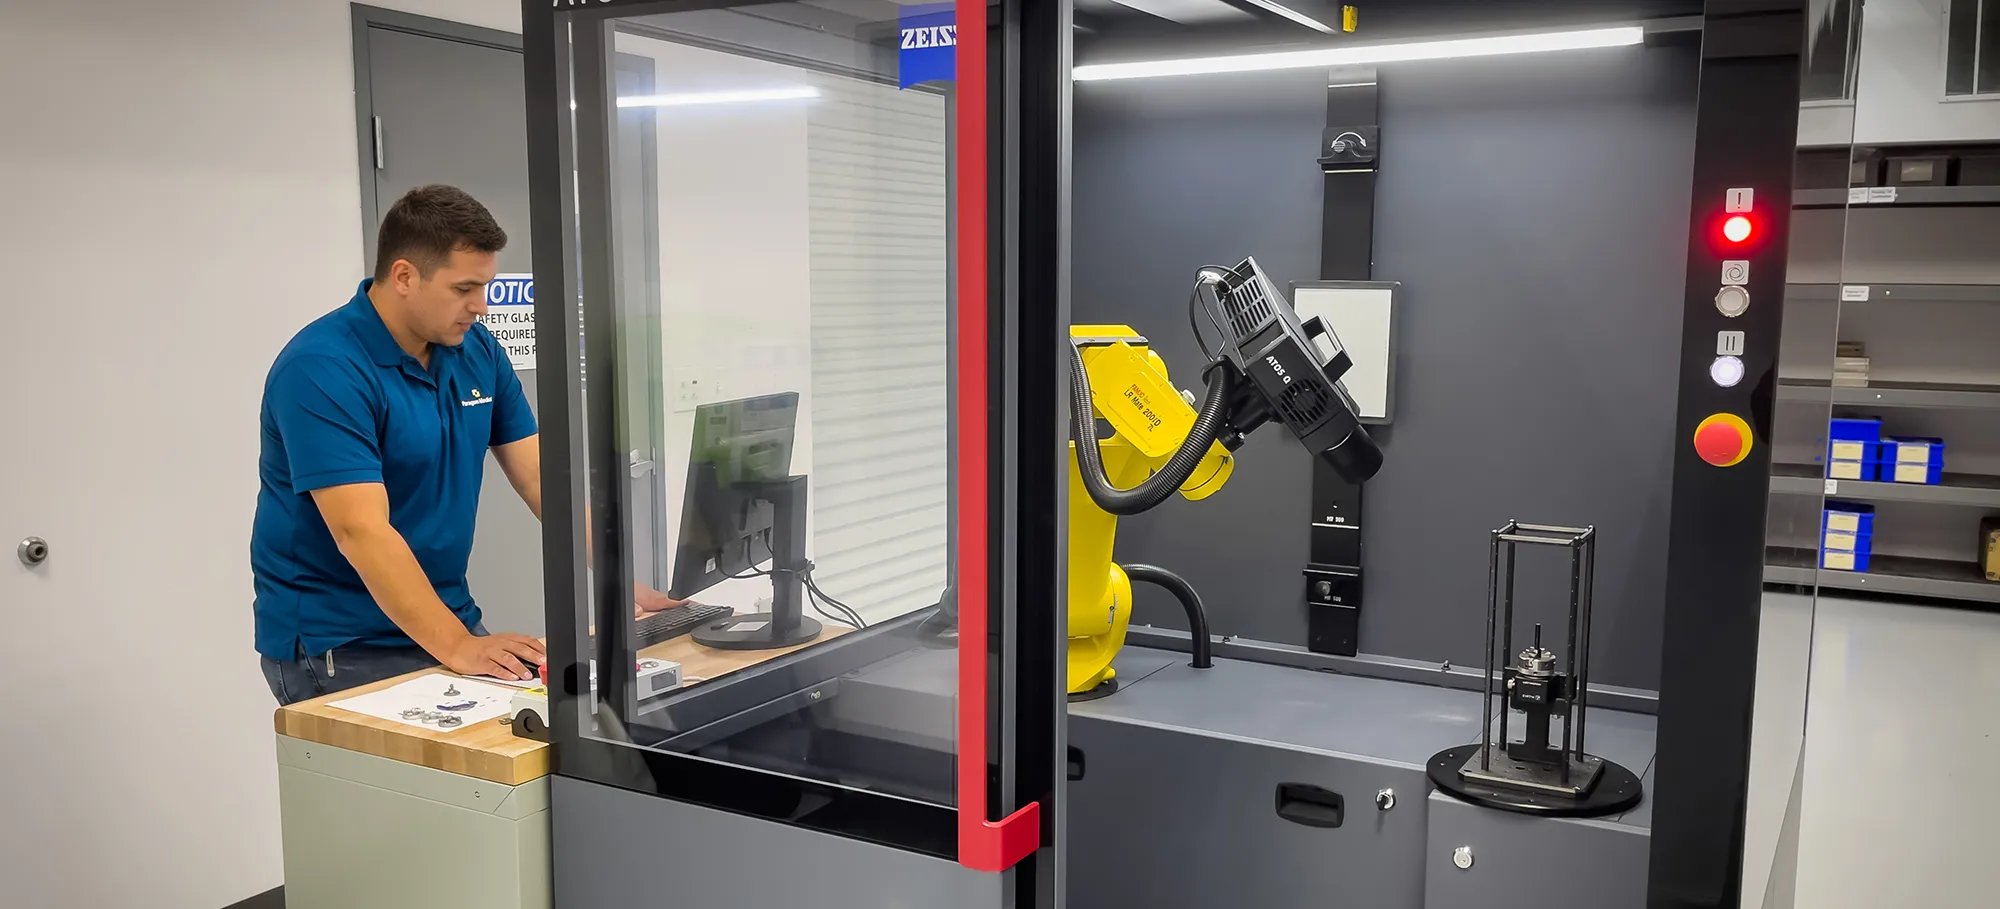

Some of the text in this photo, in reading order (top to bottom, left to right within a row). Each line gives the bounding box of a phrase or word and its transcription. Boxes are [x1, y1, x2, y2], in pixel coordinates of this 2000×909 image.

[901, 25, 957, 49] ZEIS
[508, 345, 530, 356] THIS
[1265, 355, 1291, 385] ATOS Q
